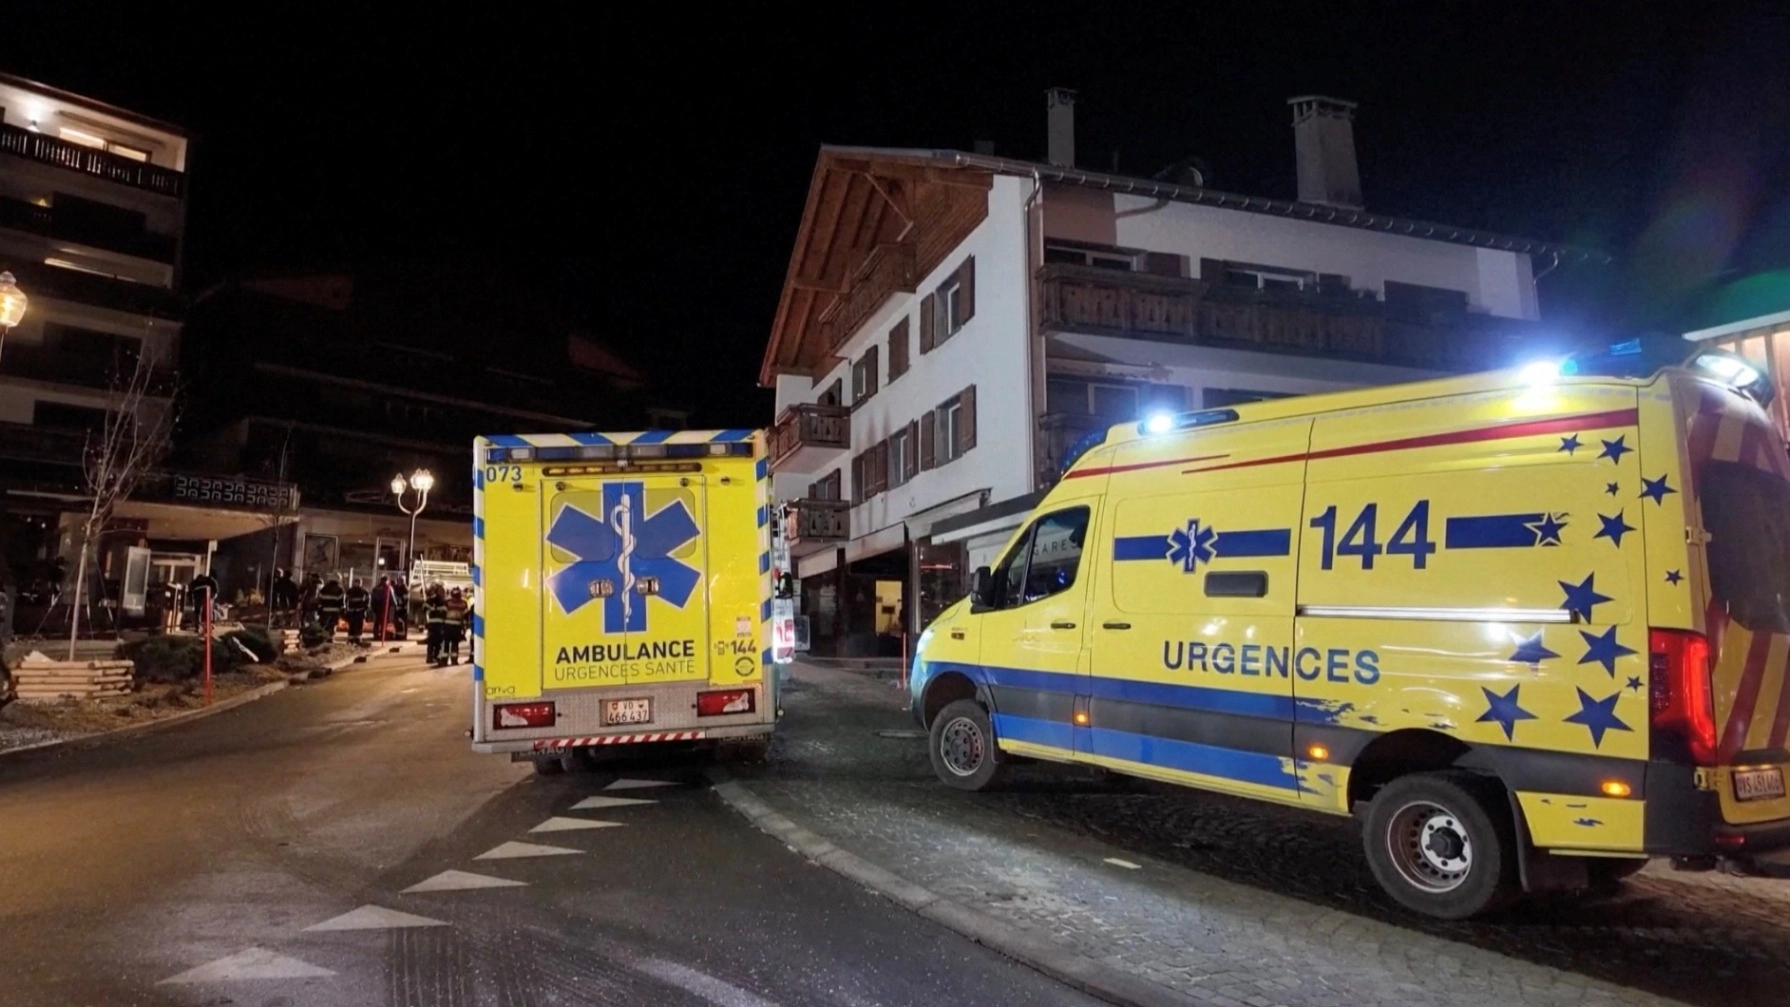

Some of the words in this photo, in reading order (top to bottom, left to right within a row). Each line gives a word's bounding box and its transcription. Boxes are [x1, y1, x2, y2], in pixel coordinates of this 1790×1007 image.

[486, 465, 522, 483] 073
[1309, 499, 1436, 570] 144
[556, 640, 695, 665] AMBULANCE
[731, 640, 757, 654] 144
[554, 663, 640, 681] URGENCES
[1164, 640, 1380, 685] URGENCES
